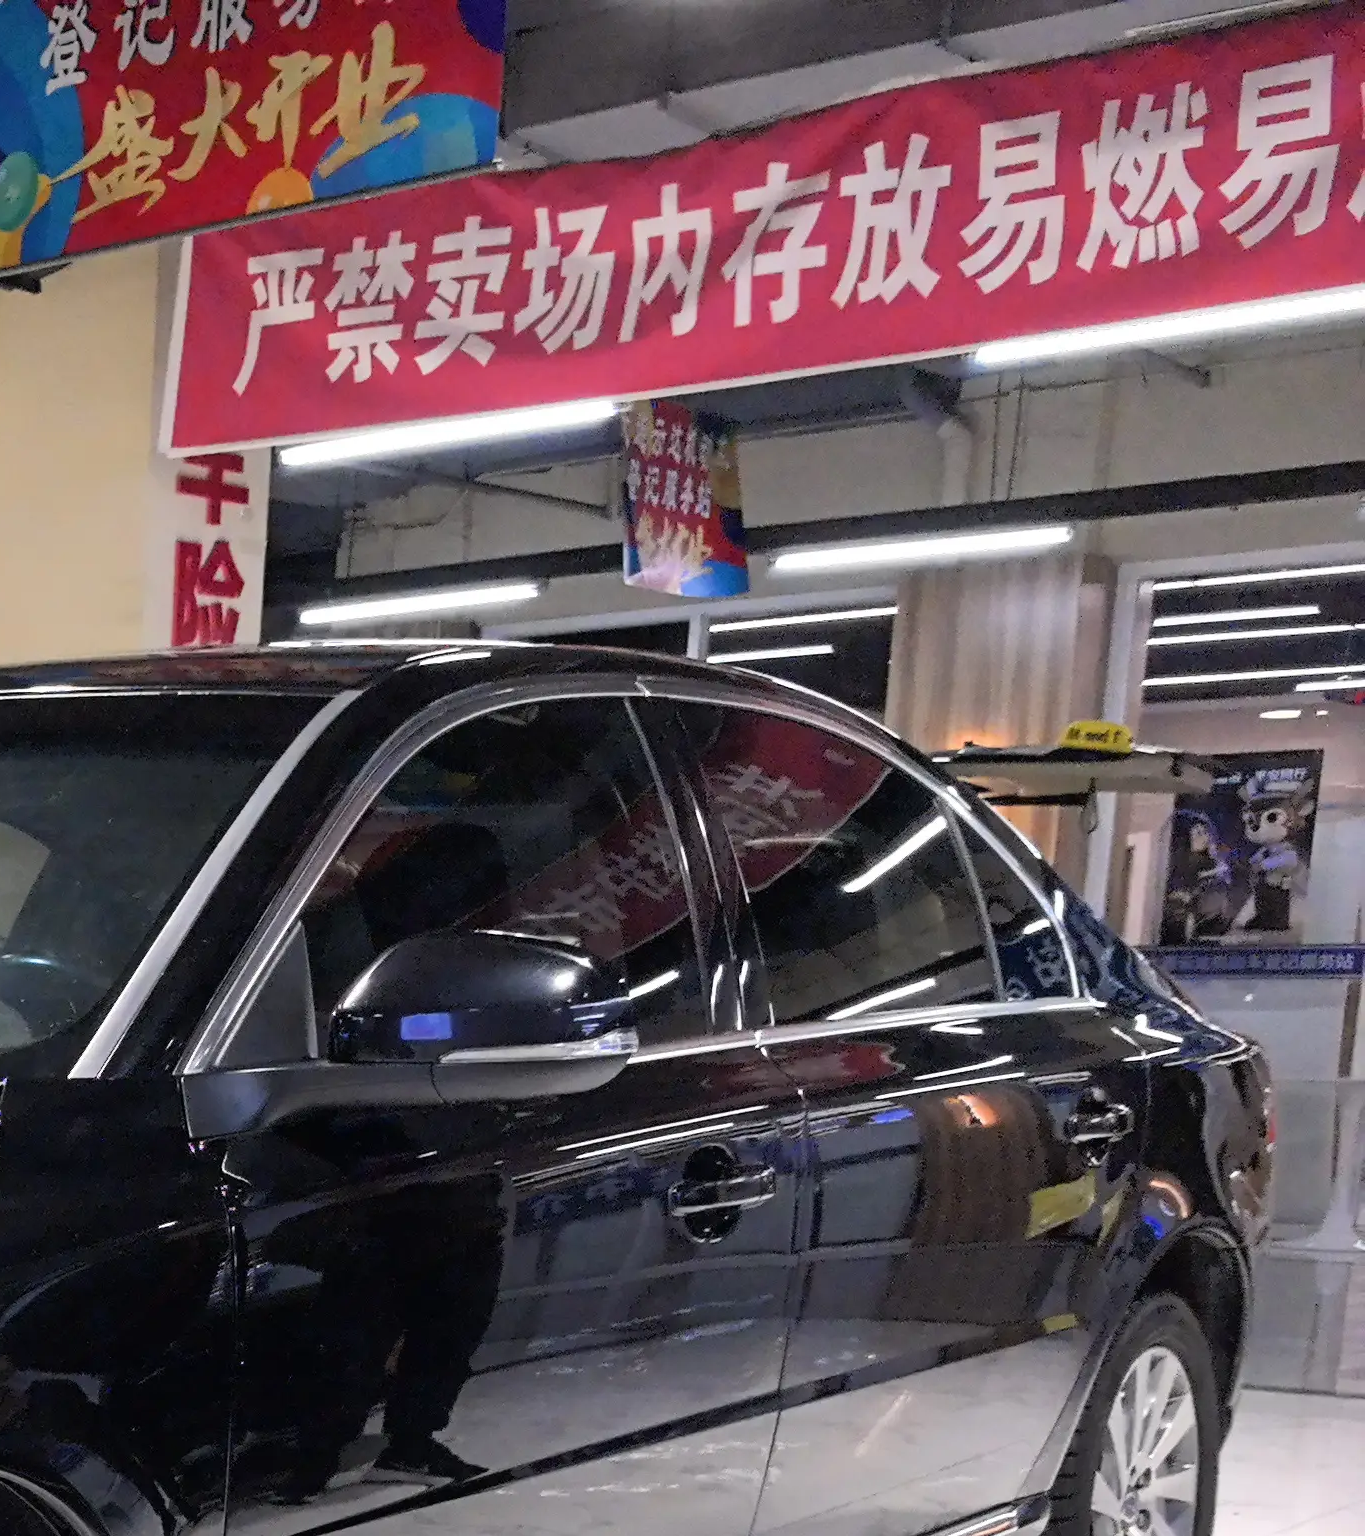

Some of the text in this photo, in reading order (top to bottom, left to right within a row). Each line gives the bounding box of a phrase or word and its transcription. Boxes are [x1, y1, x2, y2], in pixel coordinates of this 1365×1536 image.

[40, 0, 384, 96] 登记服
[48, 20, 427, 224] 盛大开业
[232, 54, 1365, 396] 严禁卖场内存放易燃易
